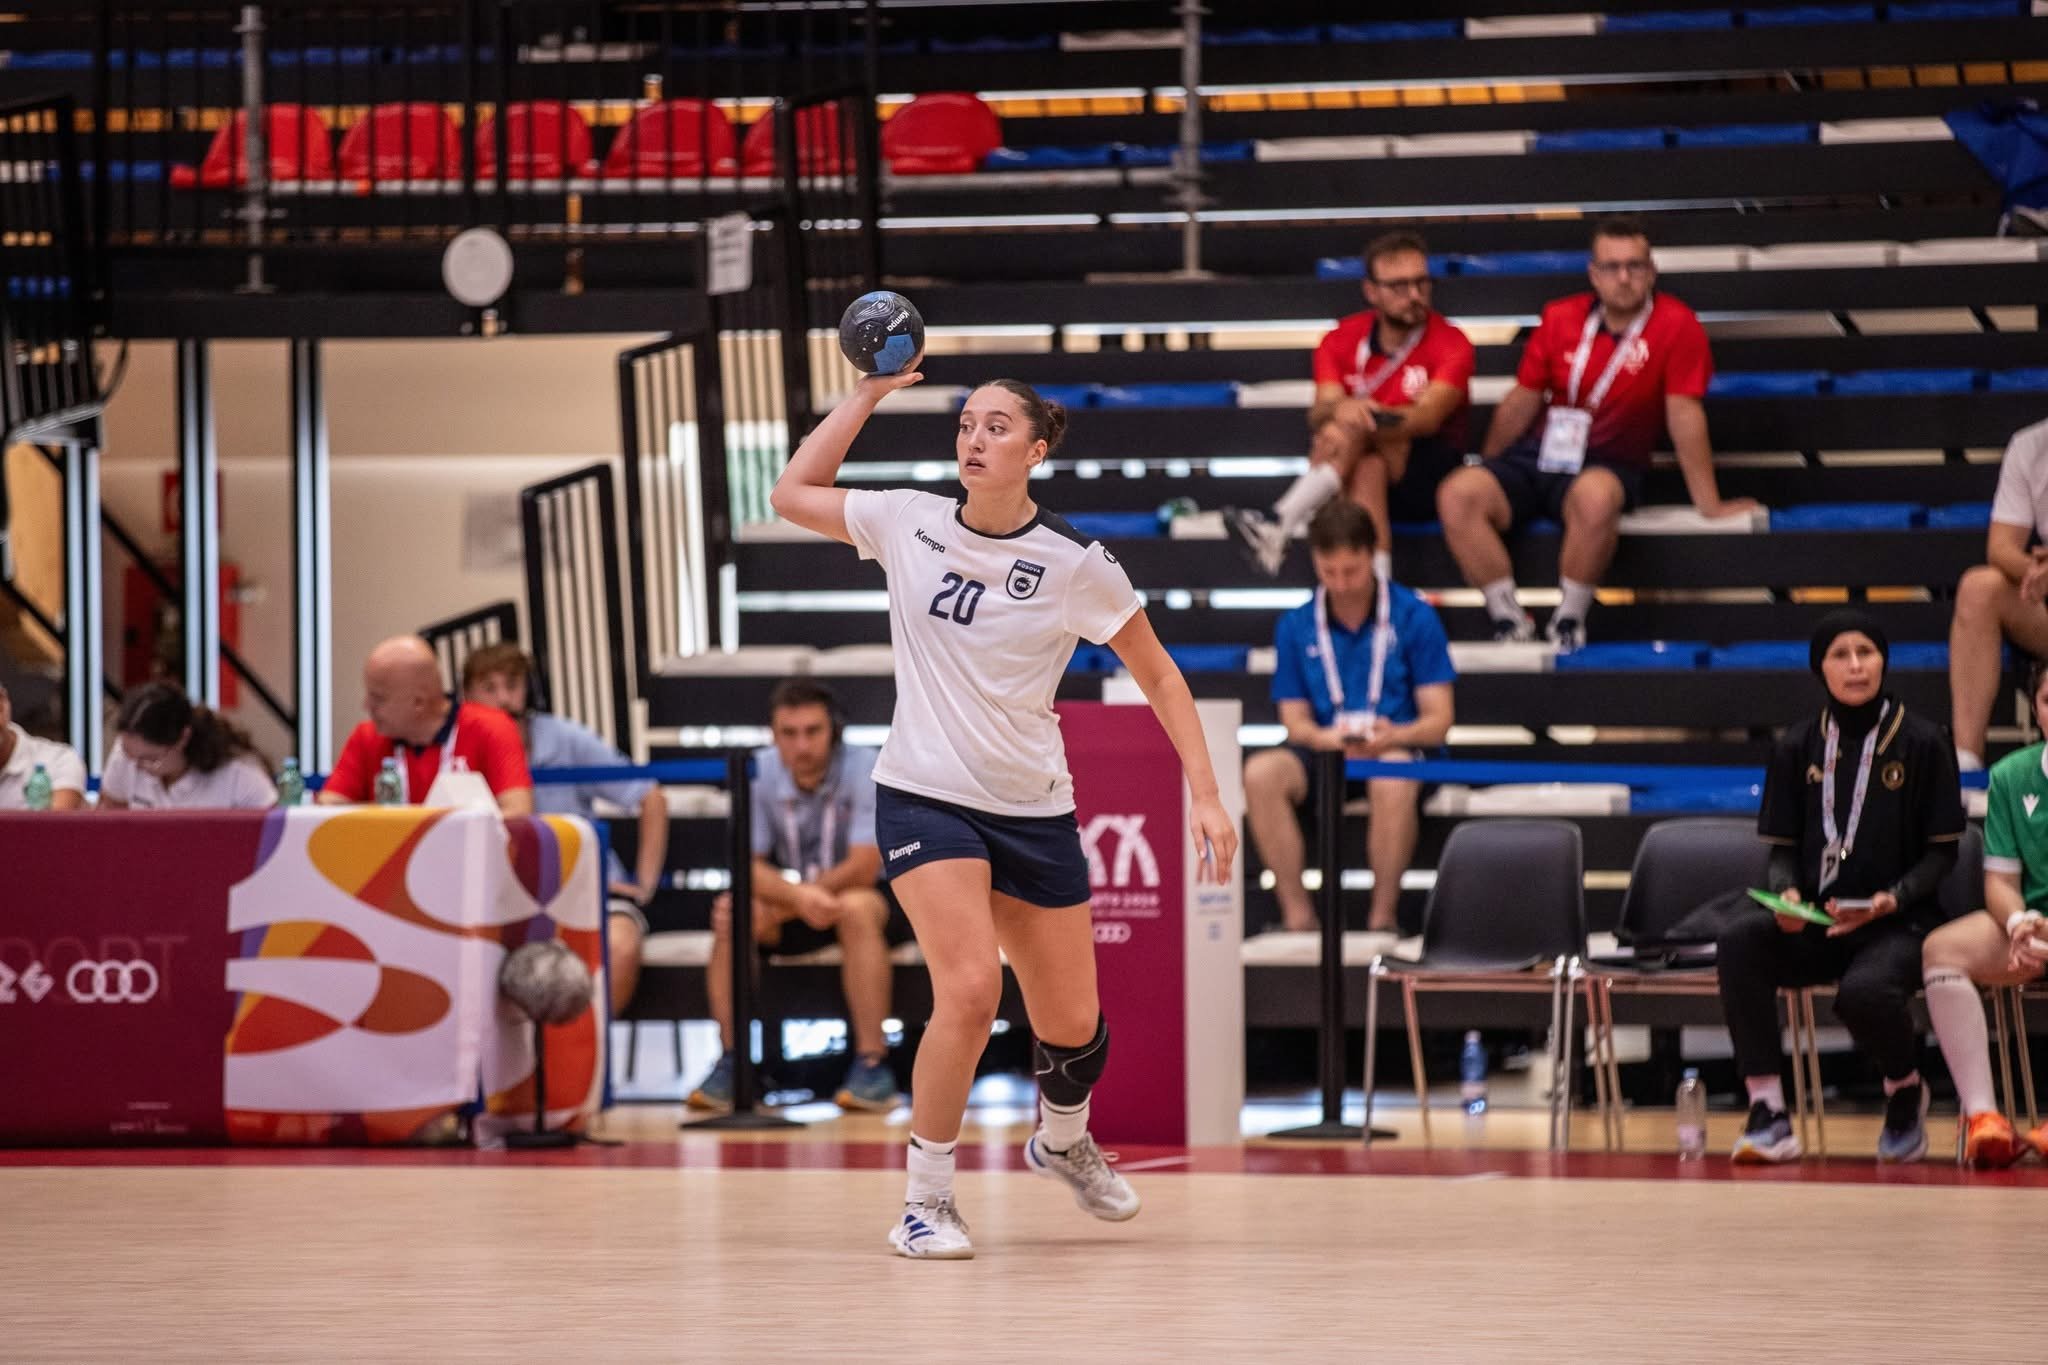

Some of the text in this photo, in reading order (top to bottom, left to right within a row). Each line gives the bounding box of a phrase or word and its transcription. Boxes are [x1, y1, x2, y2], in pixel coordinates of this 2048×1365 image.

[886, 310, 911, 332] Kempa
[914, 528, 946, 554] Kempa
[1017, 561, 1041, 573] KOSOVA
[928, 571, 986, 626] 20
[889, 841, 921, 861] Kempa
